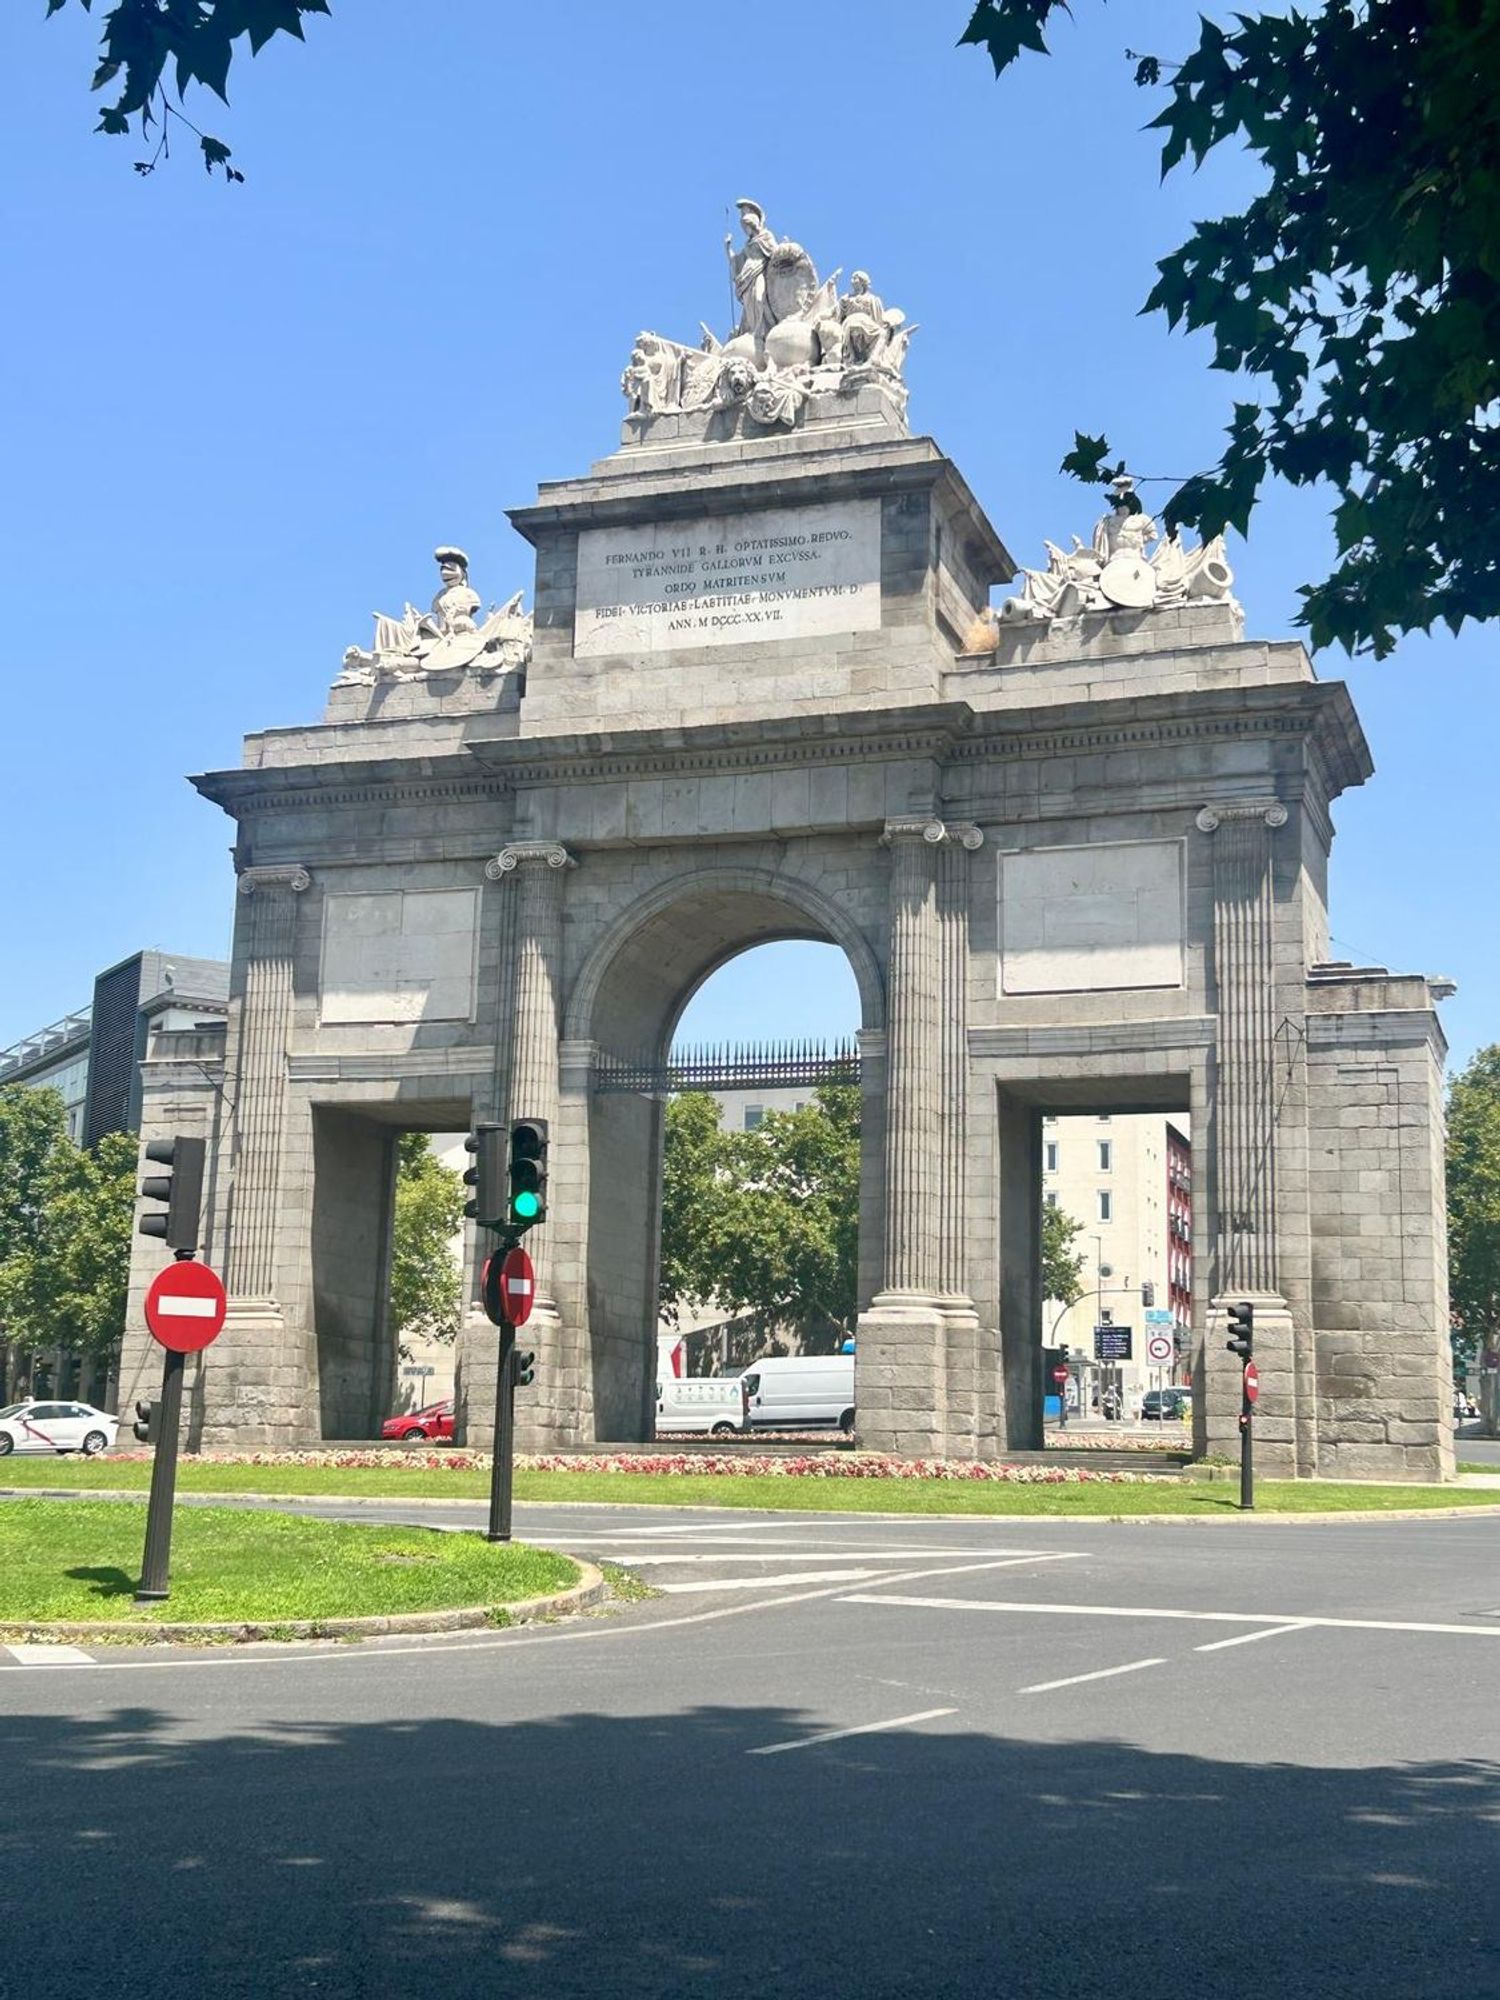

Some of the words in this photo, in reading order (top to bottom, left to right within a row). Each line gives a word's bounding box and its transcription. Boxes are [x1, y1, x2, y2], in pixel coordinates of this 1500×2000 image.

[605, 551, 665, 565] FERNANDO
[672, 547, 691, 559] VII
[632, 563, 695, 579] TYRANNIDE
[701, 555, 762, 572] GALLORVM
